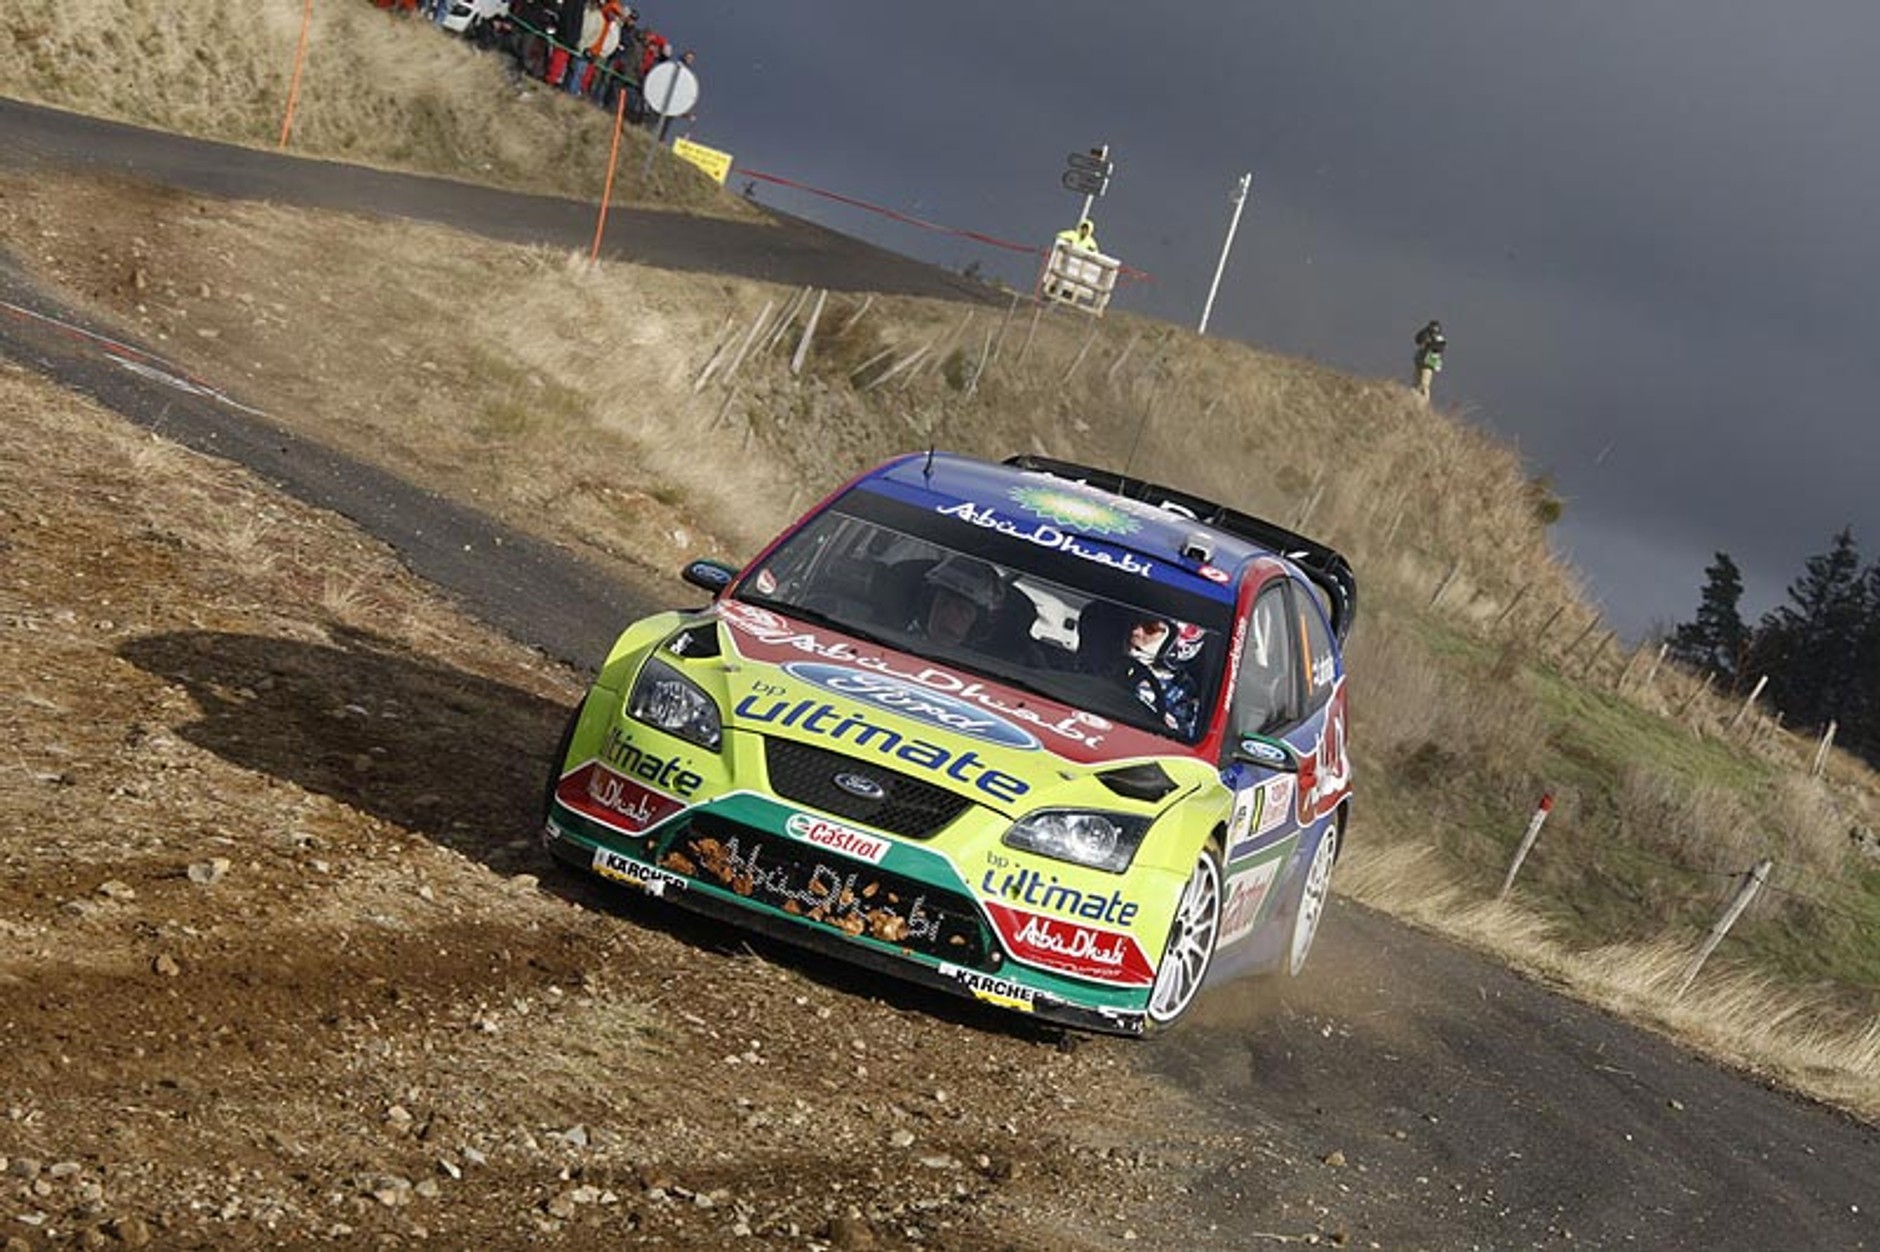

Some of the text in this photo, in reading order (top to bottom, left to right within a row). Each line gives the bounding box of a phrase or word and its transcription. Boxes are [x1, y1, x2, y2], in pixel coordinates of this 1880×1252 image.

[751, 680, 787, 698] bp
[826, 674, 996, 735] Ford
[602, 727, 704, 797] timate
[734, 695, 1030, 803] ultimate
[808, 821, 883, 861] Castrol
[986, 851, 1009, 869] bp
[982, 868, 1139, 926] ultimate
